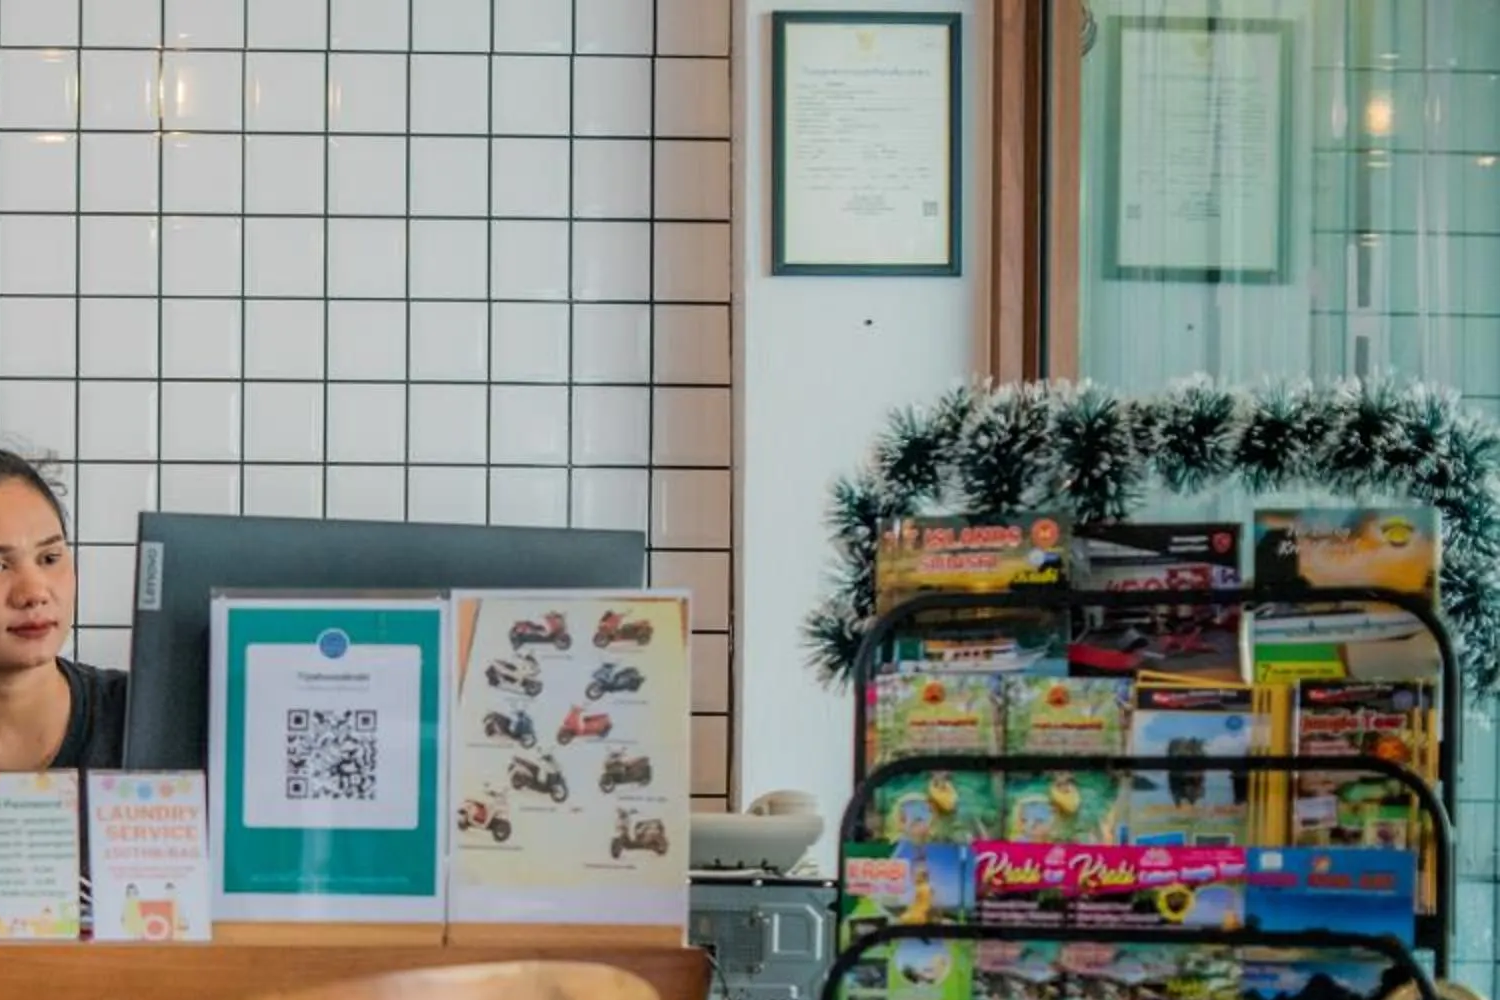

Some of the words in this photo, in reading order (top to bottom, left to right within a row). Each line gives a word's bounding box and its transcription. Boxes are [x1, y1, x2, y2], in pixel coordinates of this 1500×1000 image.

[143, 547, 158, 605] Lenovo
[96, 805, 199, 822] LAUNDRY
[104, 825, 198, 841] SERVICE
